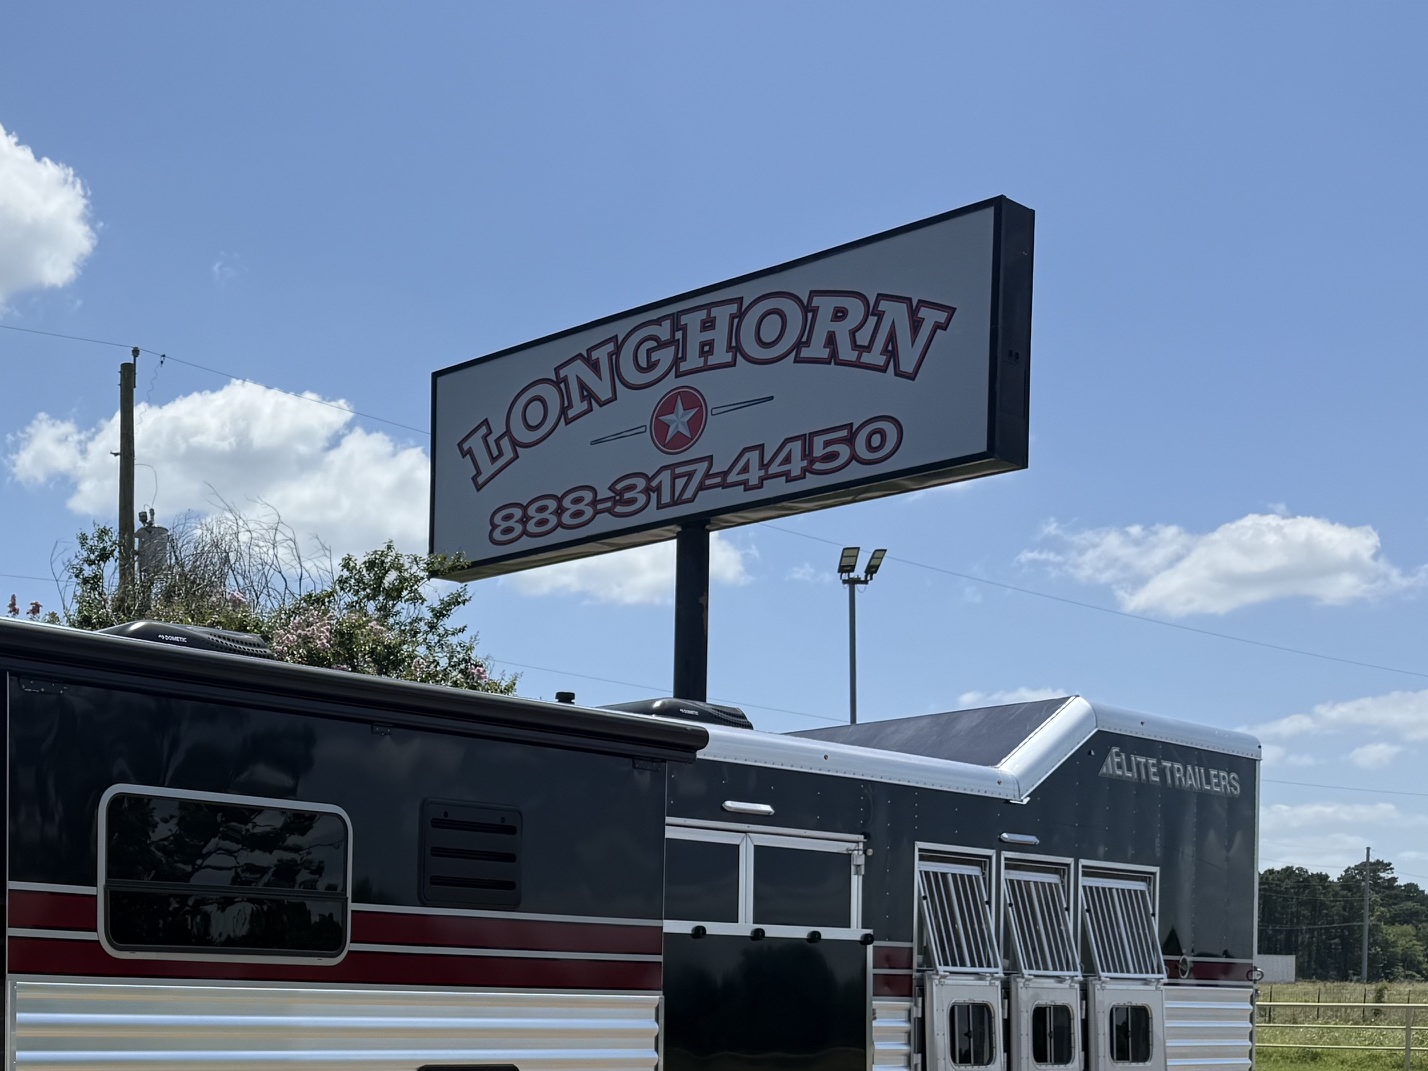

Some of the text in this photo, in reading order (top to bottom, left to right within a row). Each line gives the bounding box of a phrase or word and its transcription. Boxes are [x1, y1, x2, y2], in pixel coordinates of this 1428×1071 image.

[458, 289, 957, 492] LONGHORN
[488, 414, 903, 546] 888-317-4450
[1161, 760, 1241, 796] TRAILERS
